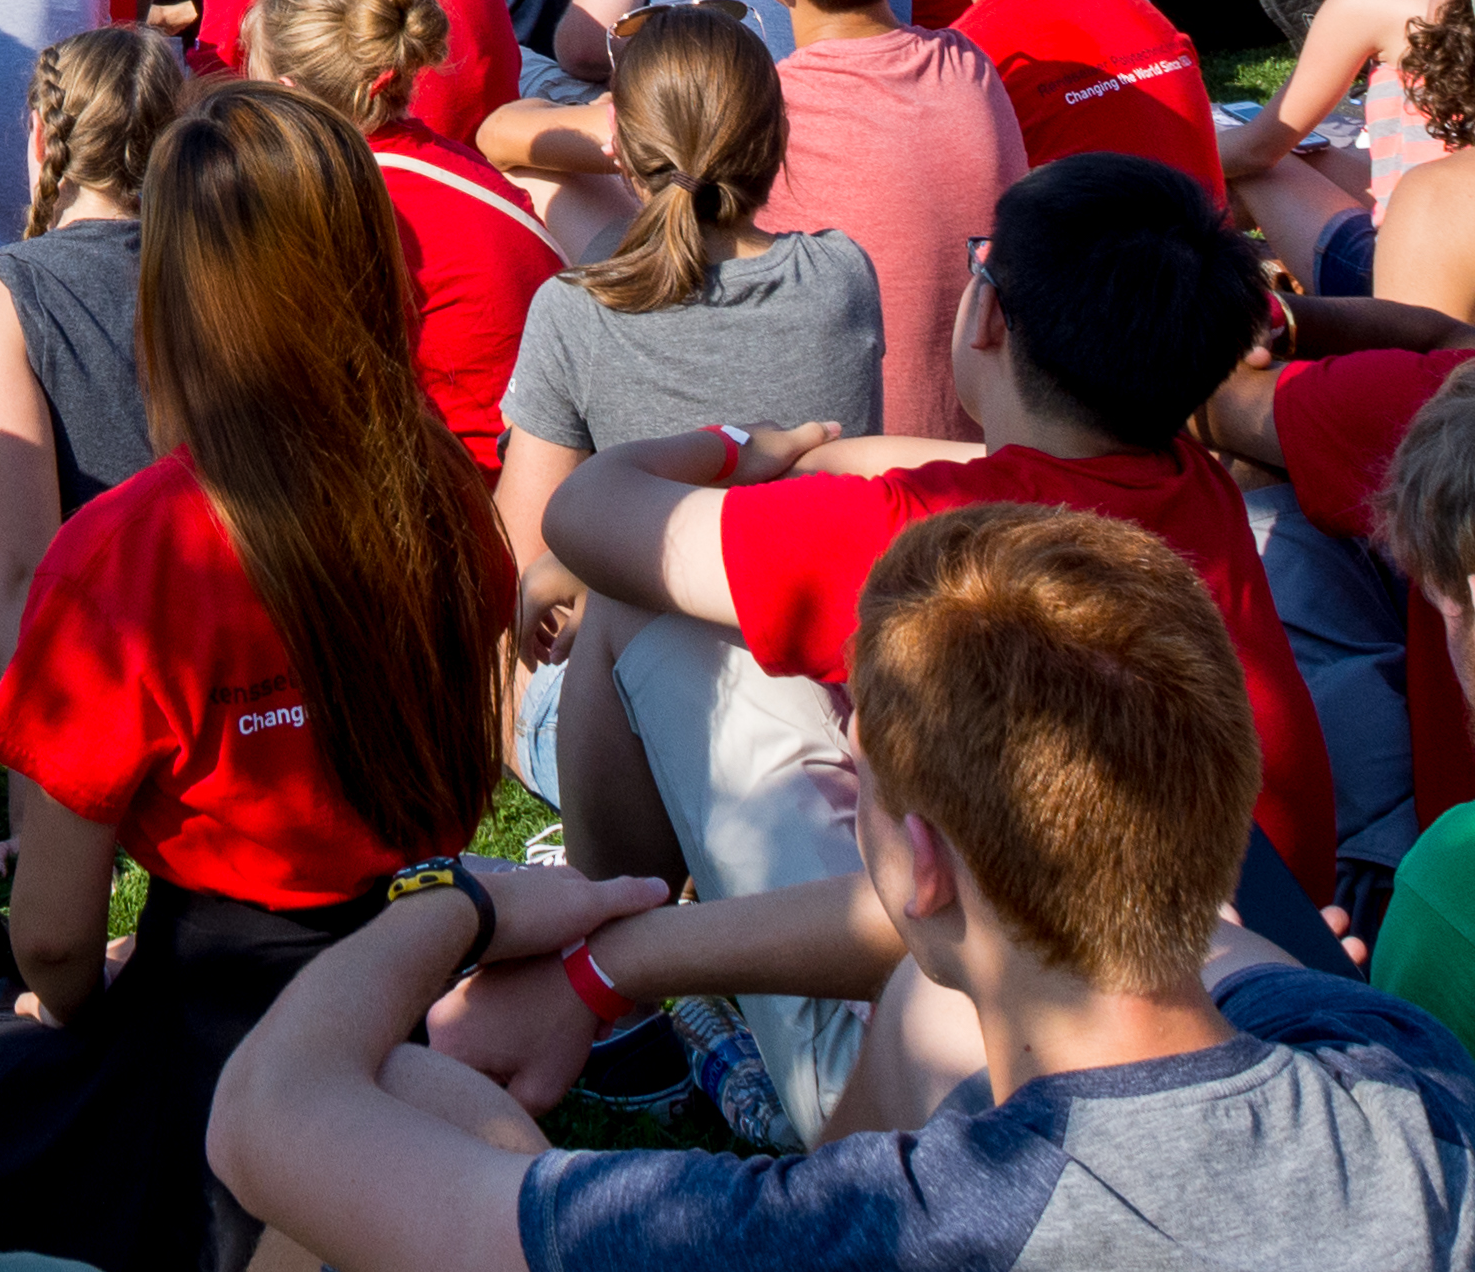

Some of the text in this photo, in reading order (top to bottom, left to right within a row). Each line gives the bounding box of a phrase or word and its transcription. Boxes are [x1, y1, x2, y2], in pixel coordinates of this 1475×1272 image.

[1064, 77, 1120, 105] Changing
[1117, 71, 1137, 85] the
[1132, 62, 1163, 82] World
